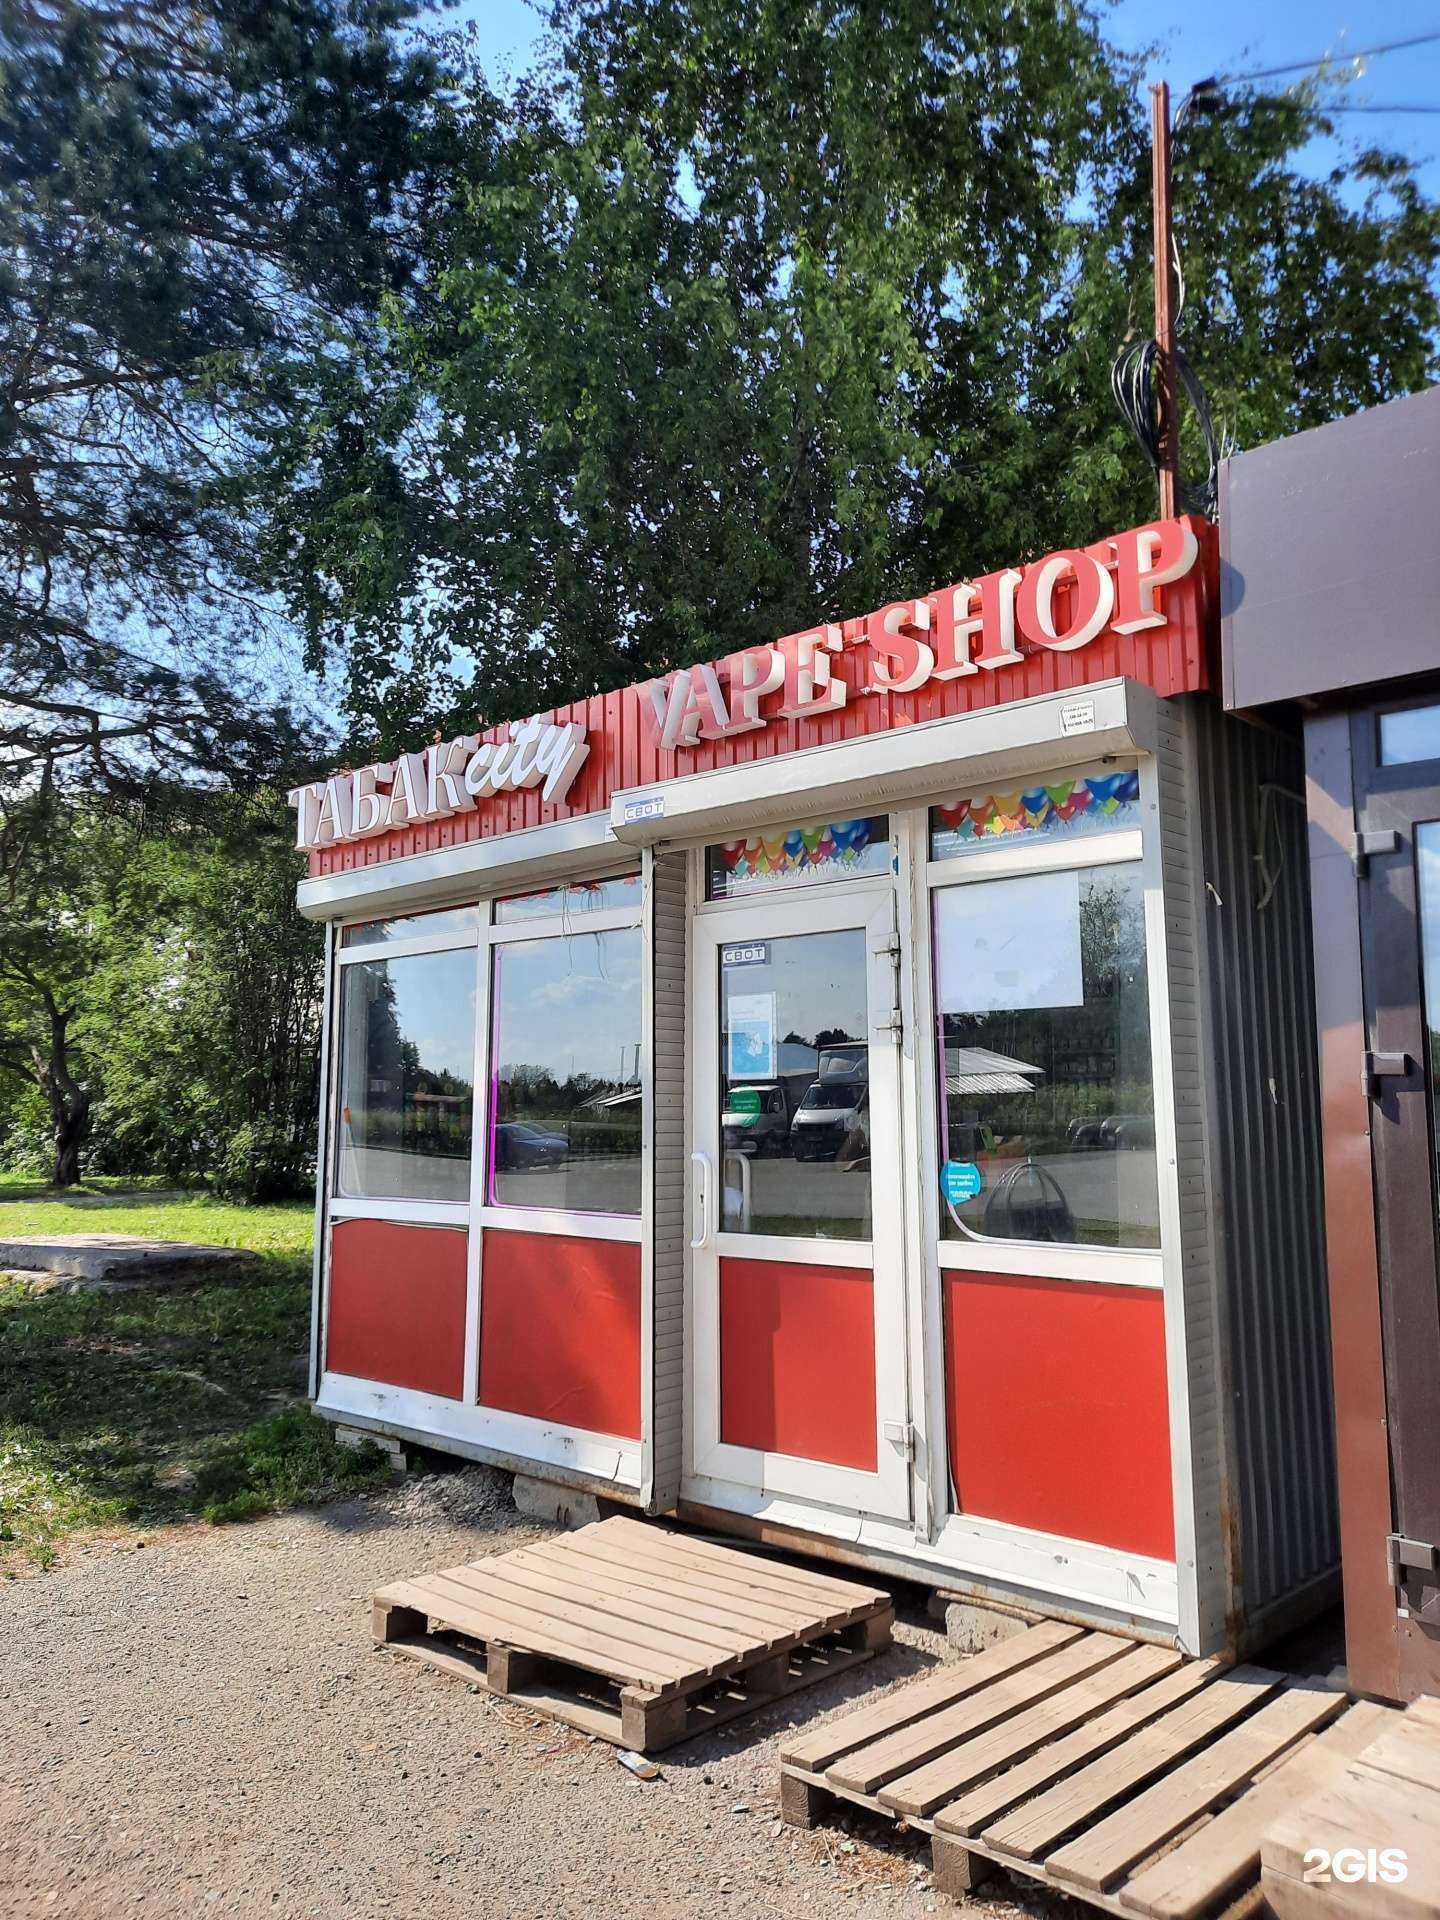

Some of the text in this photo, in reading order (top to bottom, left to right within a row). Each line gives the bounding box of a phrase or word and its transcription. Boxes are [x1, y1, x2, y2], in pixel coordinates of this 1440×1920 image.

[638, 517, 1198, 750] VAPE SHOP
[287, 713, 584, 850] ТАБАК city
